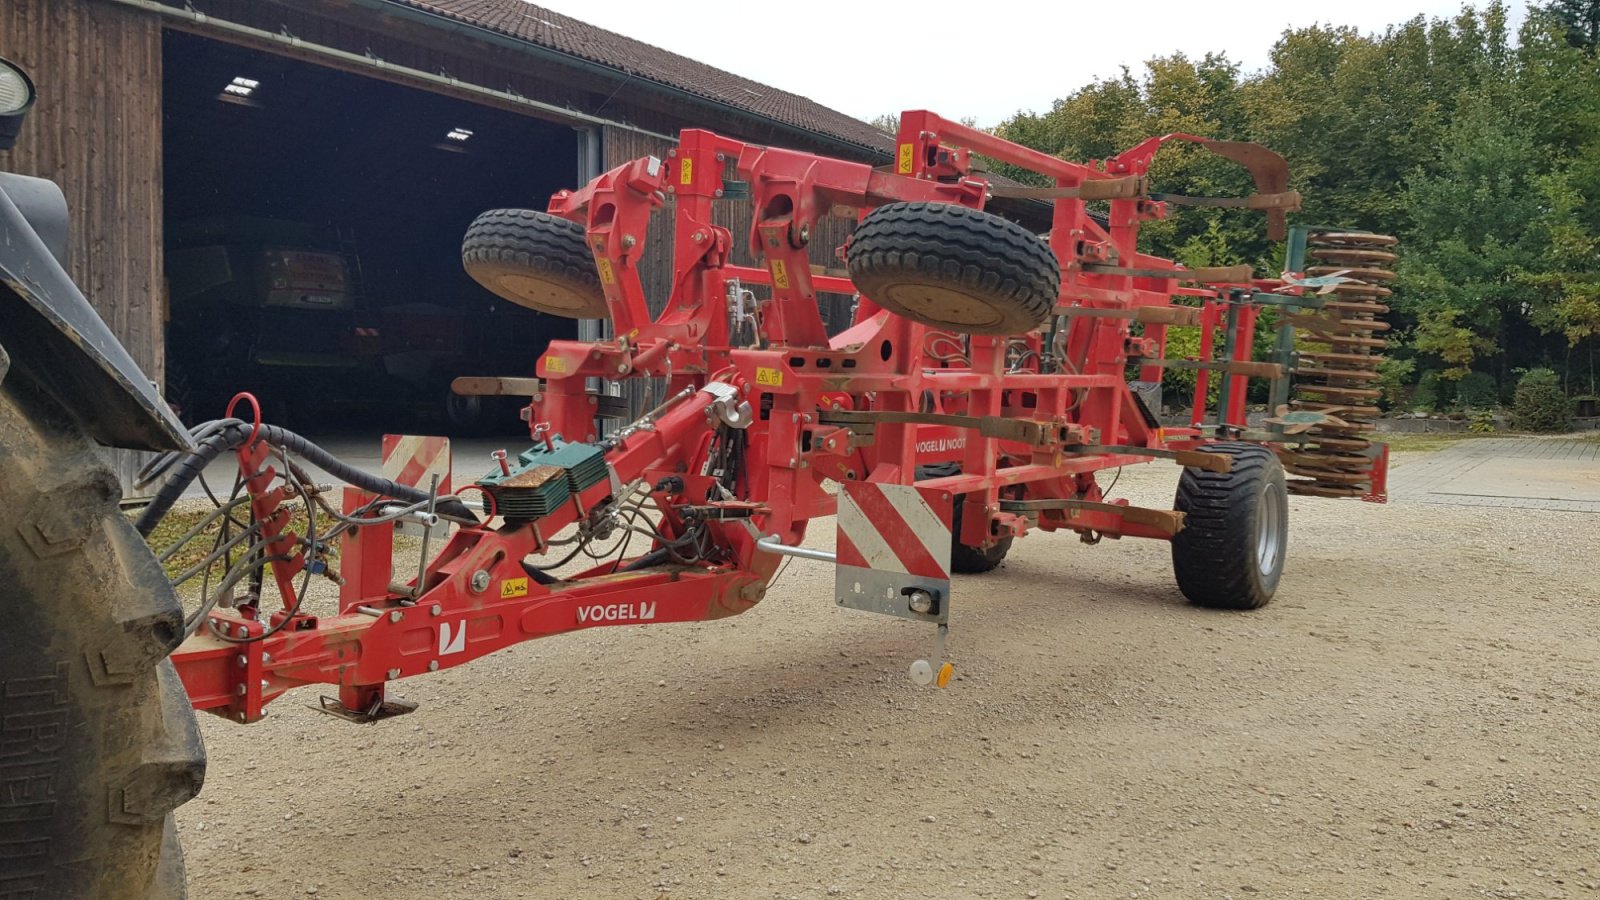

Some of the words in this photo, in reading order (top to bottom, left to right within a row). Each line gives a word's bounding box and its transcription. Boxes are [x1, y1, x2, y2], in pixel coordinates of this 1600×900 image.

[916, 441, 938, 453] VOGEL
[947, 438, 966, 449] NOOT
[577, 604, 637, 624] VOGEL
